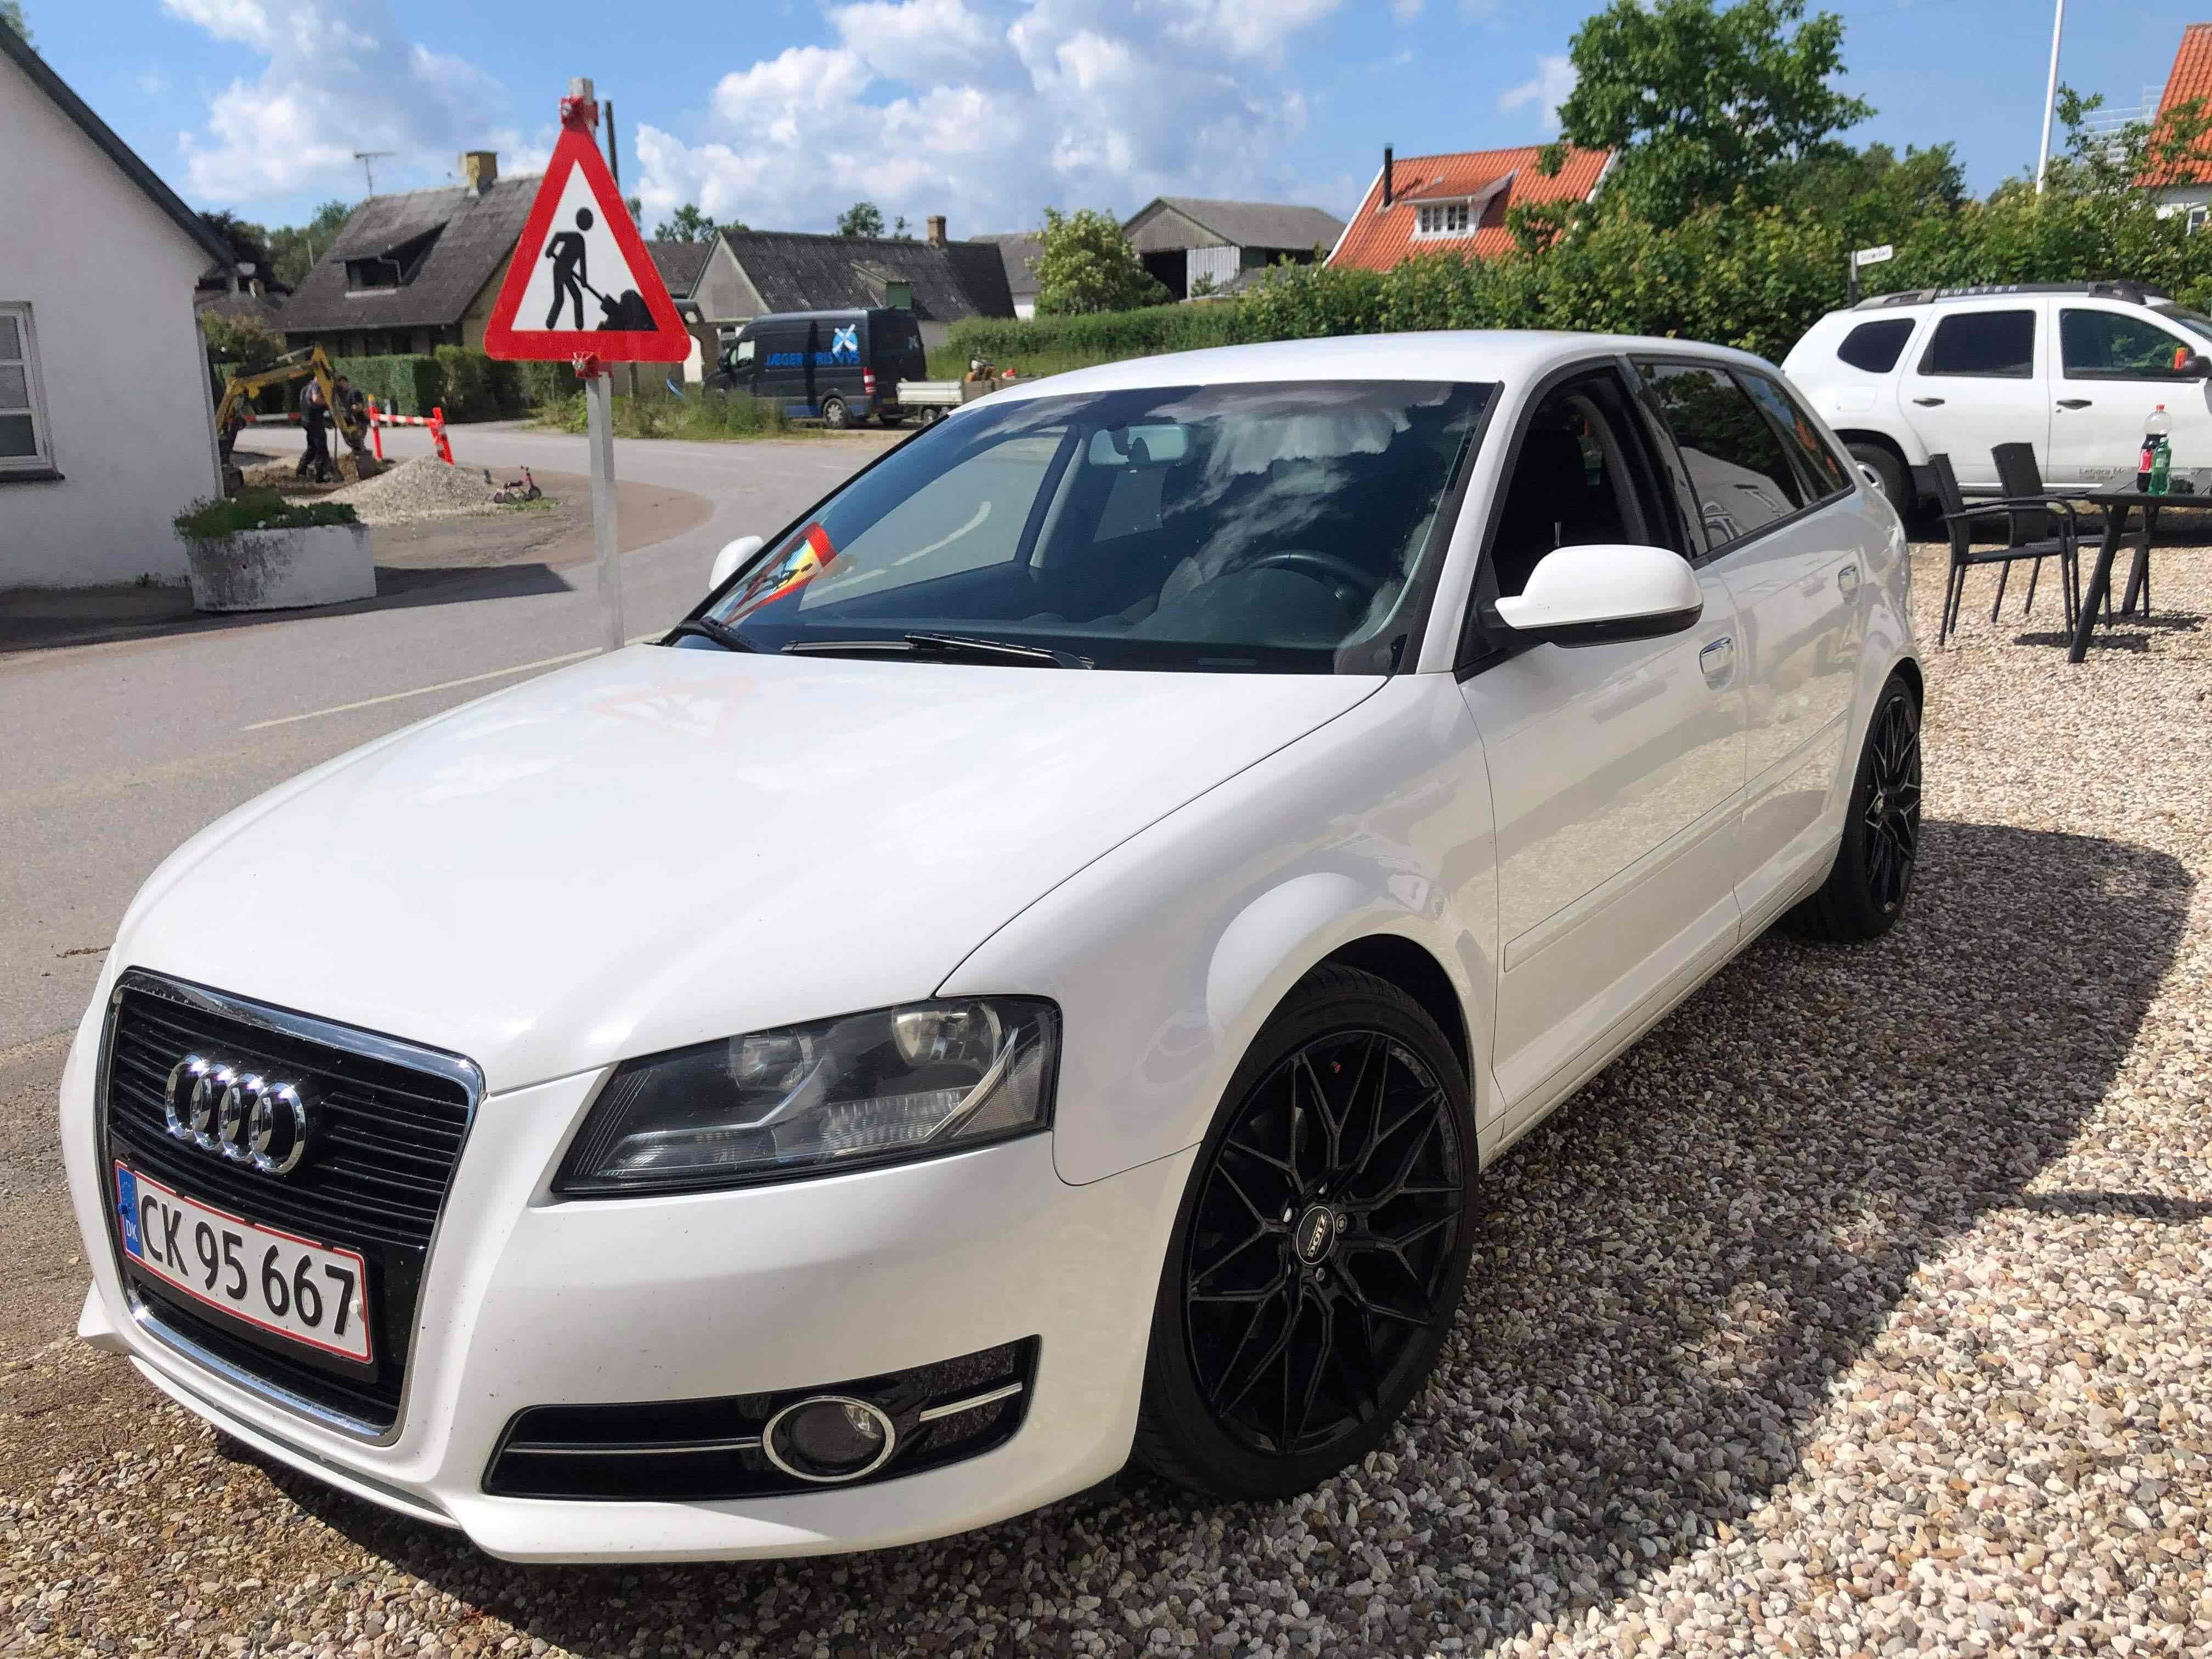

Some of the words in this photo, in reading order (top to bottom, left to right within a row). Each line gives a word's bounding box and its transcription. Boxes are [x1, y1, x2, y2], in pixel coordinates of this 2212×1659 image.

[126, 1218, 138, 1243] DK
[1307, 1214, 1326, 1258] DOTZ
[141, 1194, 189, 1277] CK
[195, 1221, 247, 1300] 95
[262, 1244, 354, 1336] 667
